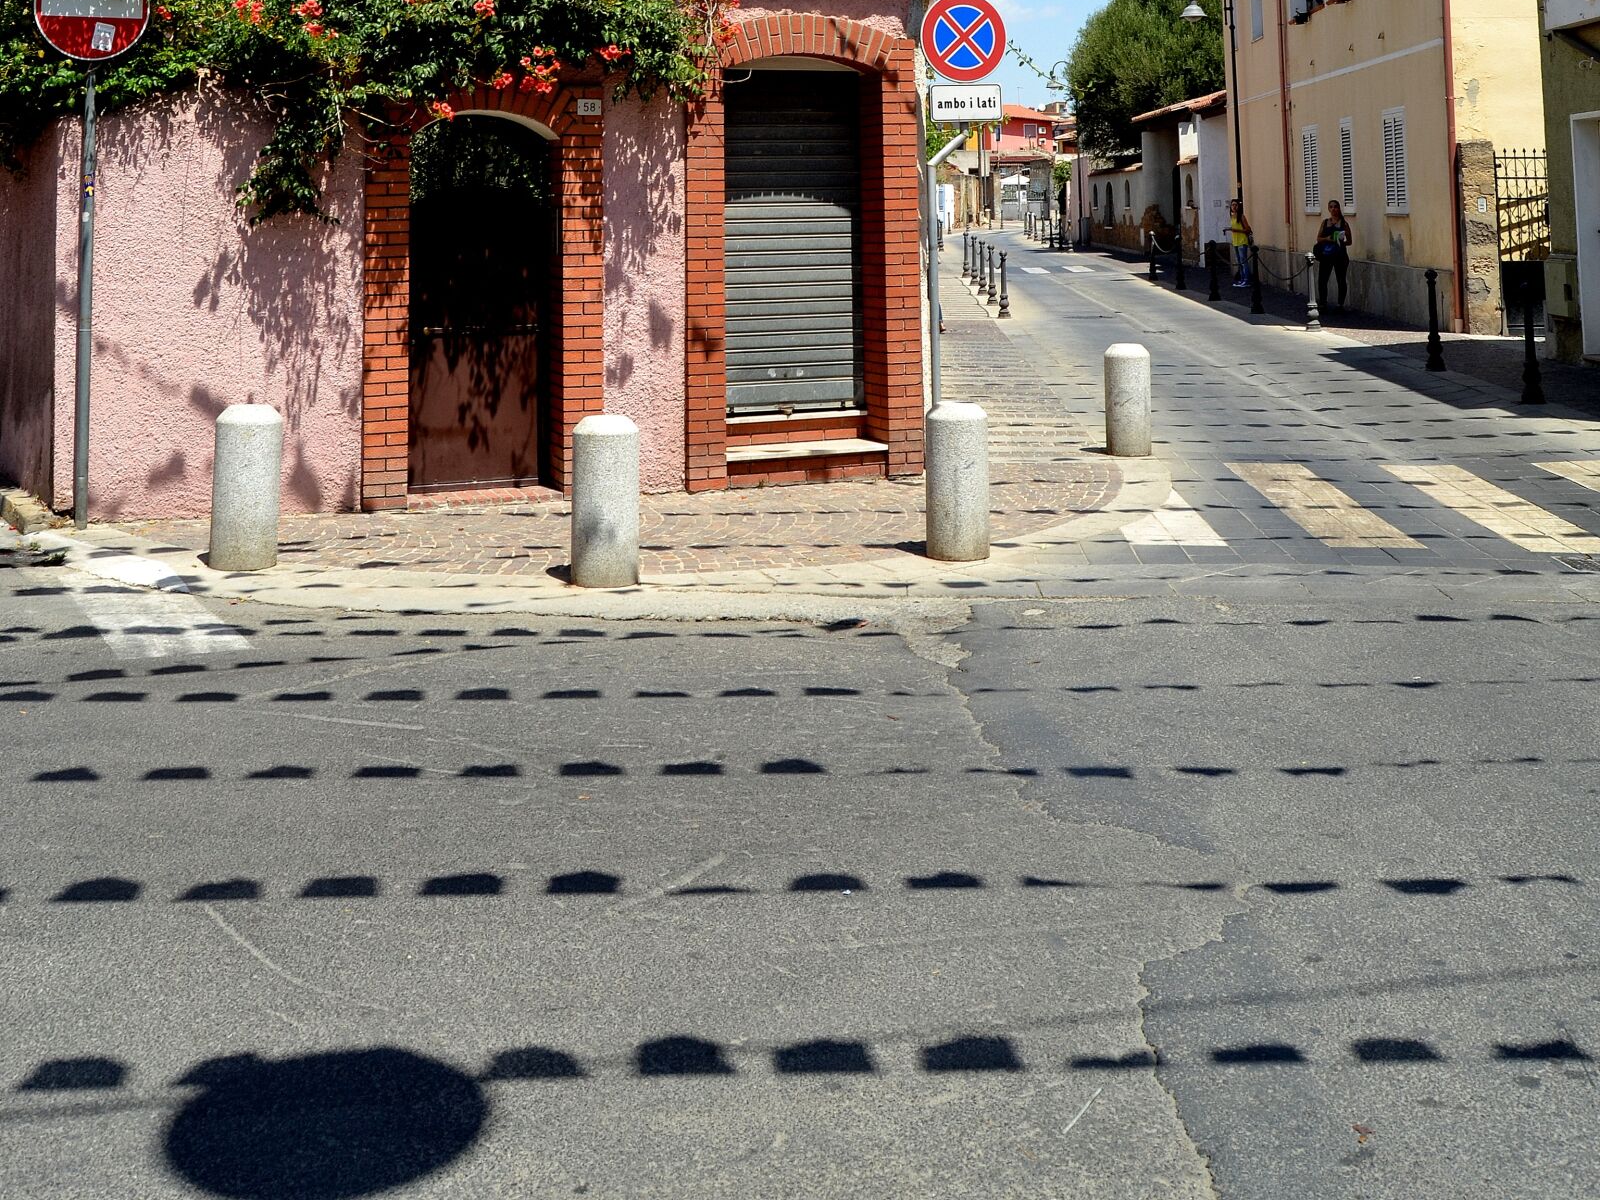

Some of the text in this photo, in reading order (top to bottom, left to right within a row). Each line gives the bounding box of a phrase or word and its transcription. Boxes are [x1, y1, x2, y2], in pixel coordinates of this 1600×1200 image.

[583, 102, 596, 112] 58
[937, 96, 996, 109] ambo i lati
